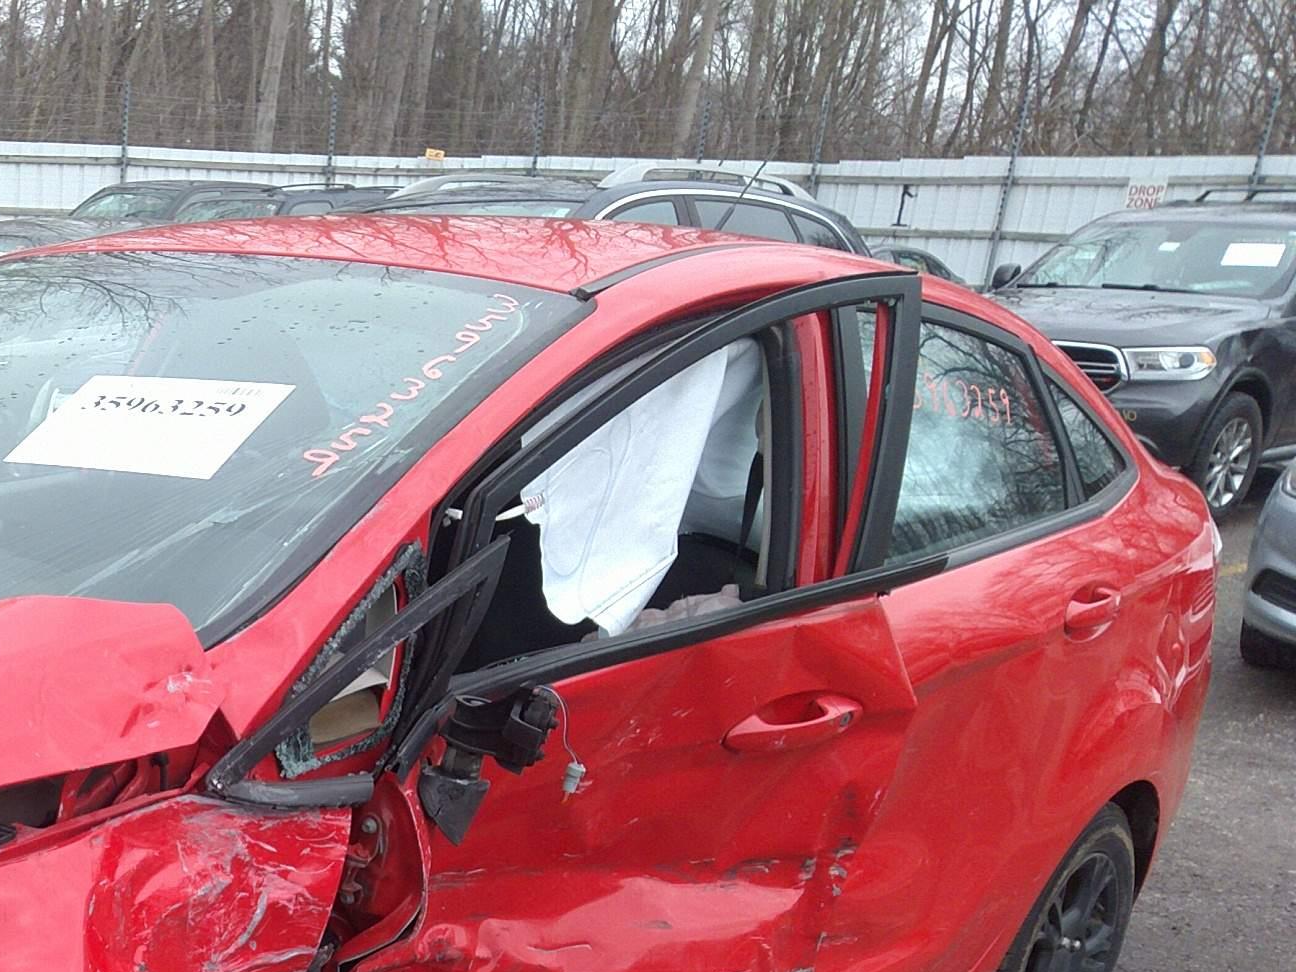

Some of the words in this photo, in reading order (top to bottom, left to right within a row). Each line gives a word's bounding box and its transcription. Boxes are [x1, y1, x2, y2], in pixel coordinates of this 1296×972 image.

[1128, 184, 1165, 197] DROP
[304, 293, 519, 477] 35963259
[81, 395, 246, 417] 35963259
